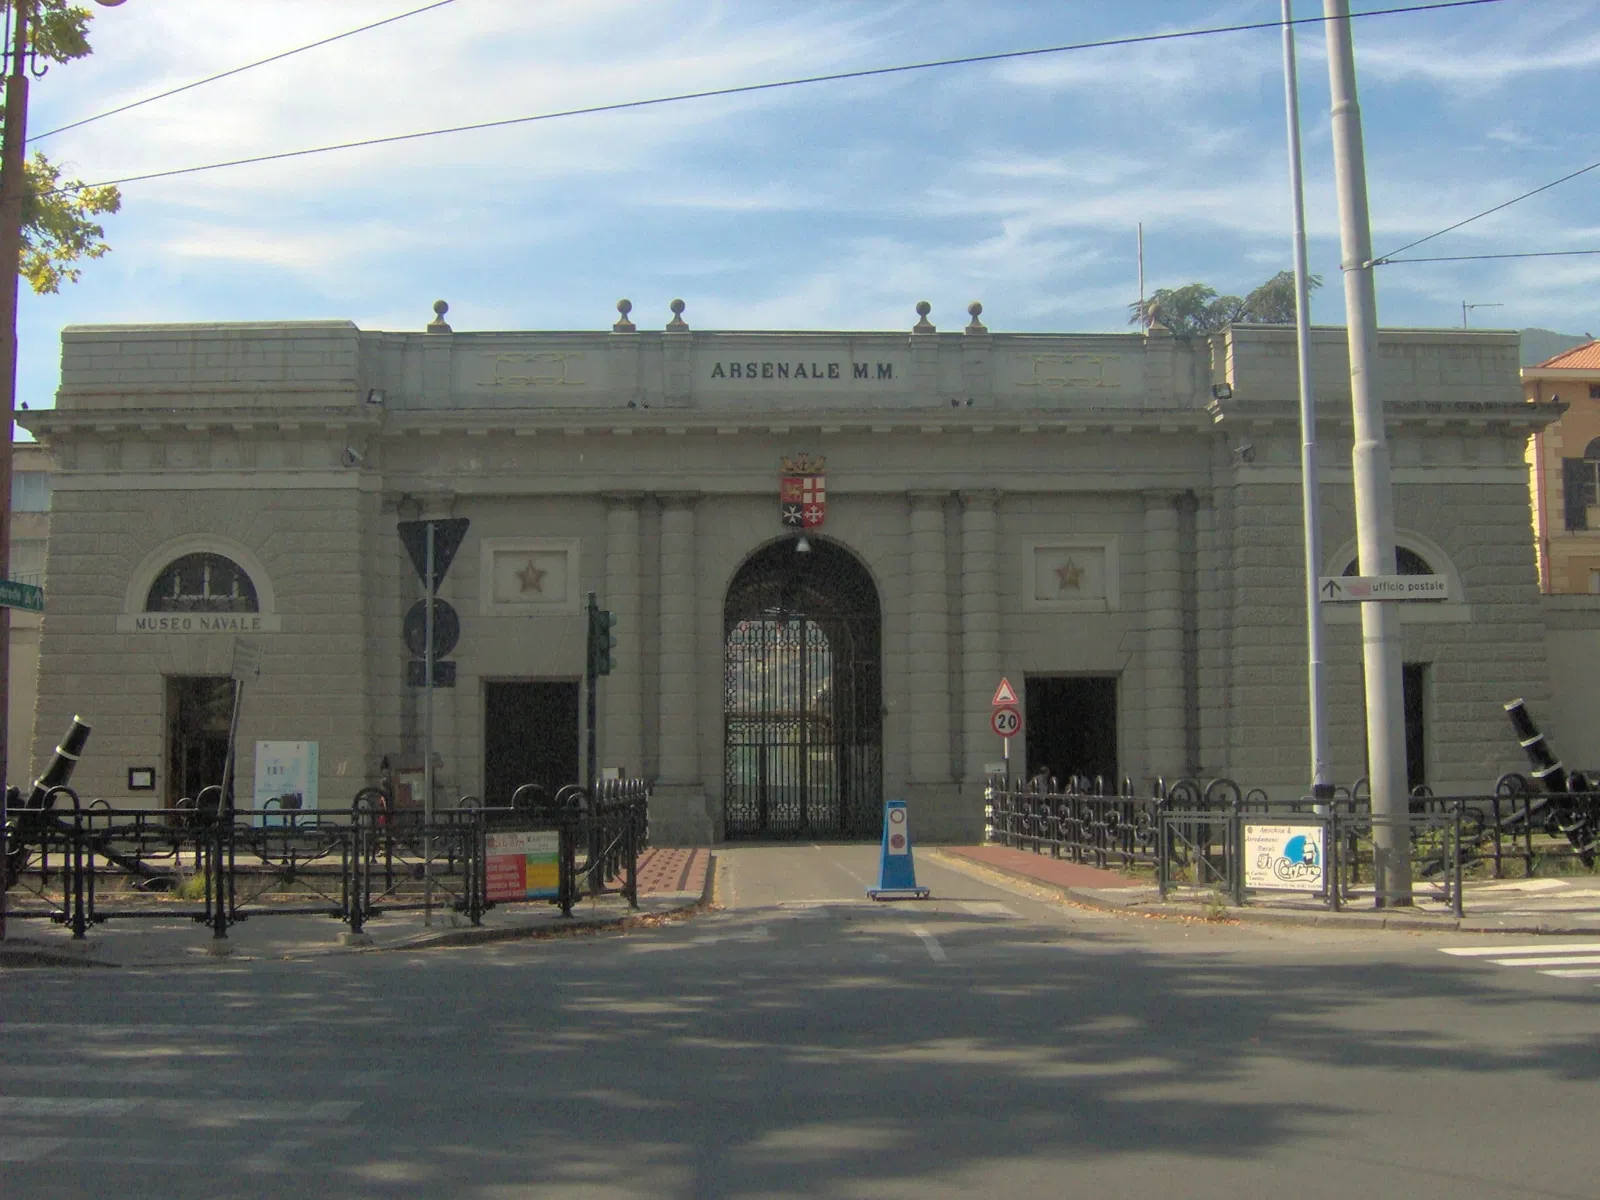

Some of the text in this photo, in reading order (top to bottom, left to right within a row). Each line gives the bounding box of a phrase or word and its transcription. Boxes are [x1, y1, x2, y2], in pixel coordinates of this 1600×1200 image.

[711, 362, 840, 379] ARSENALE
[1372, 581, 1444, 592] ufficio postale
[136, 617, 261, 630] MUSEO NAVALE
[998, 714, 1017, 730] 20
